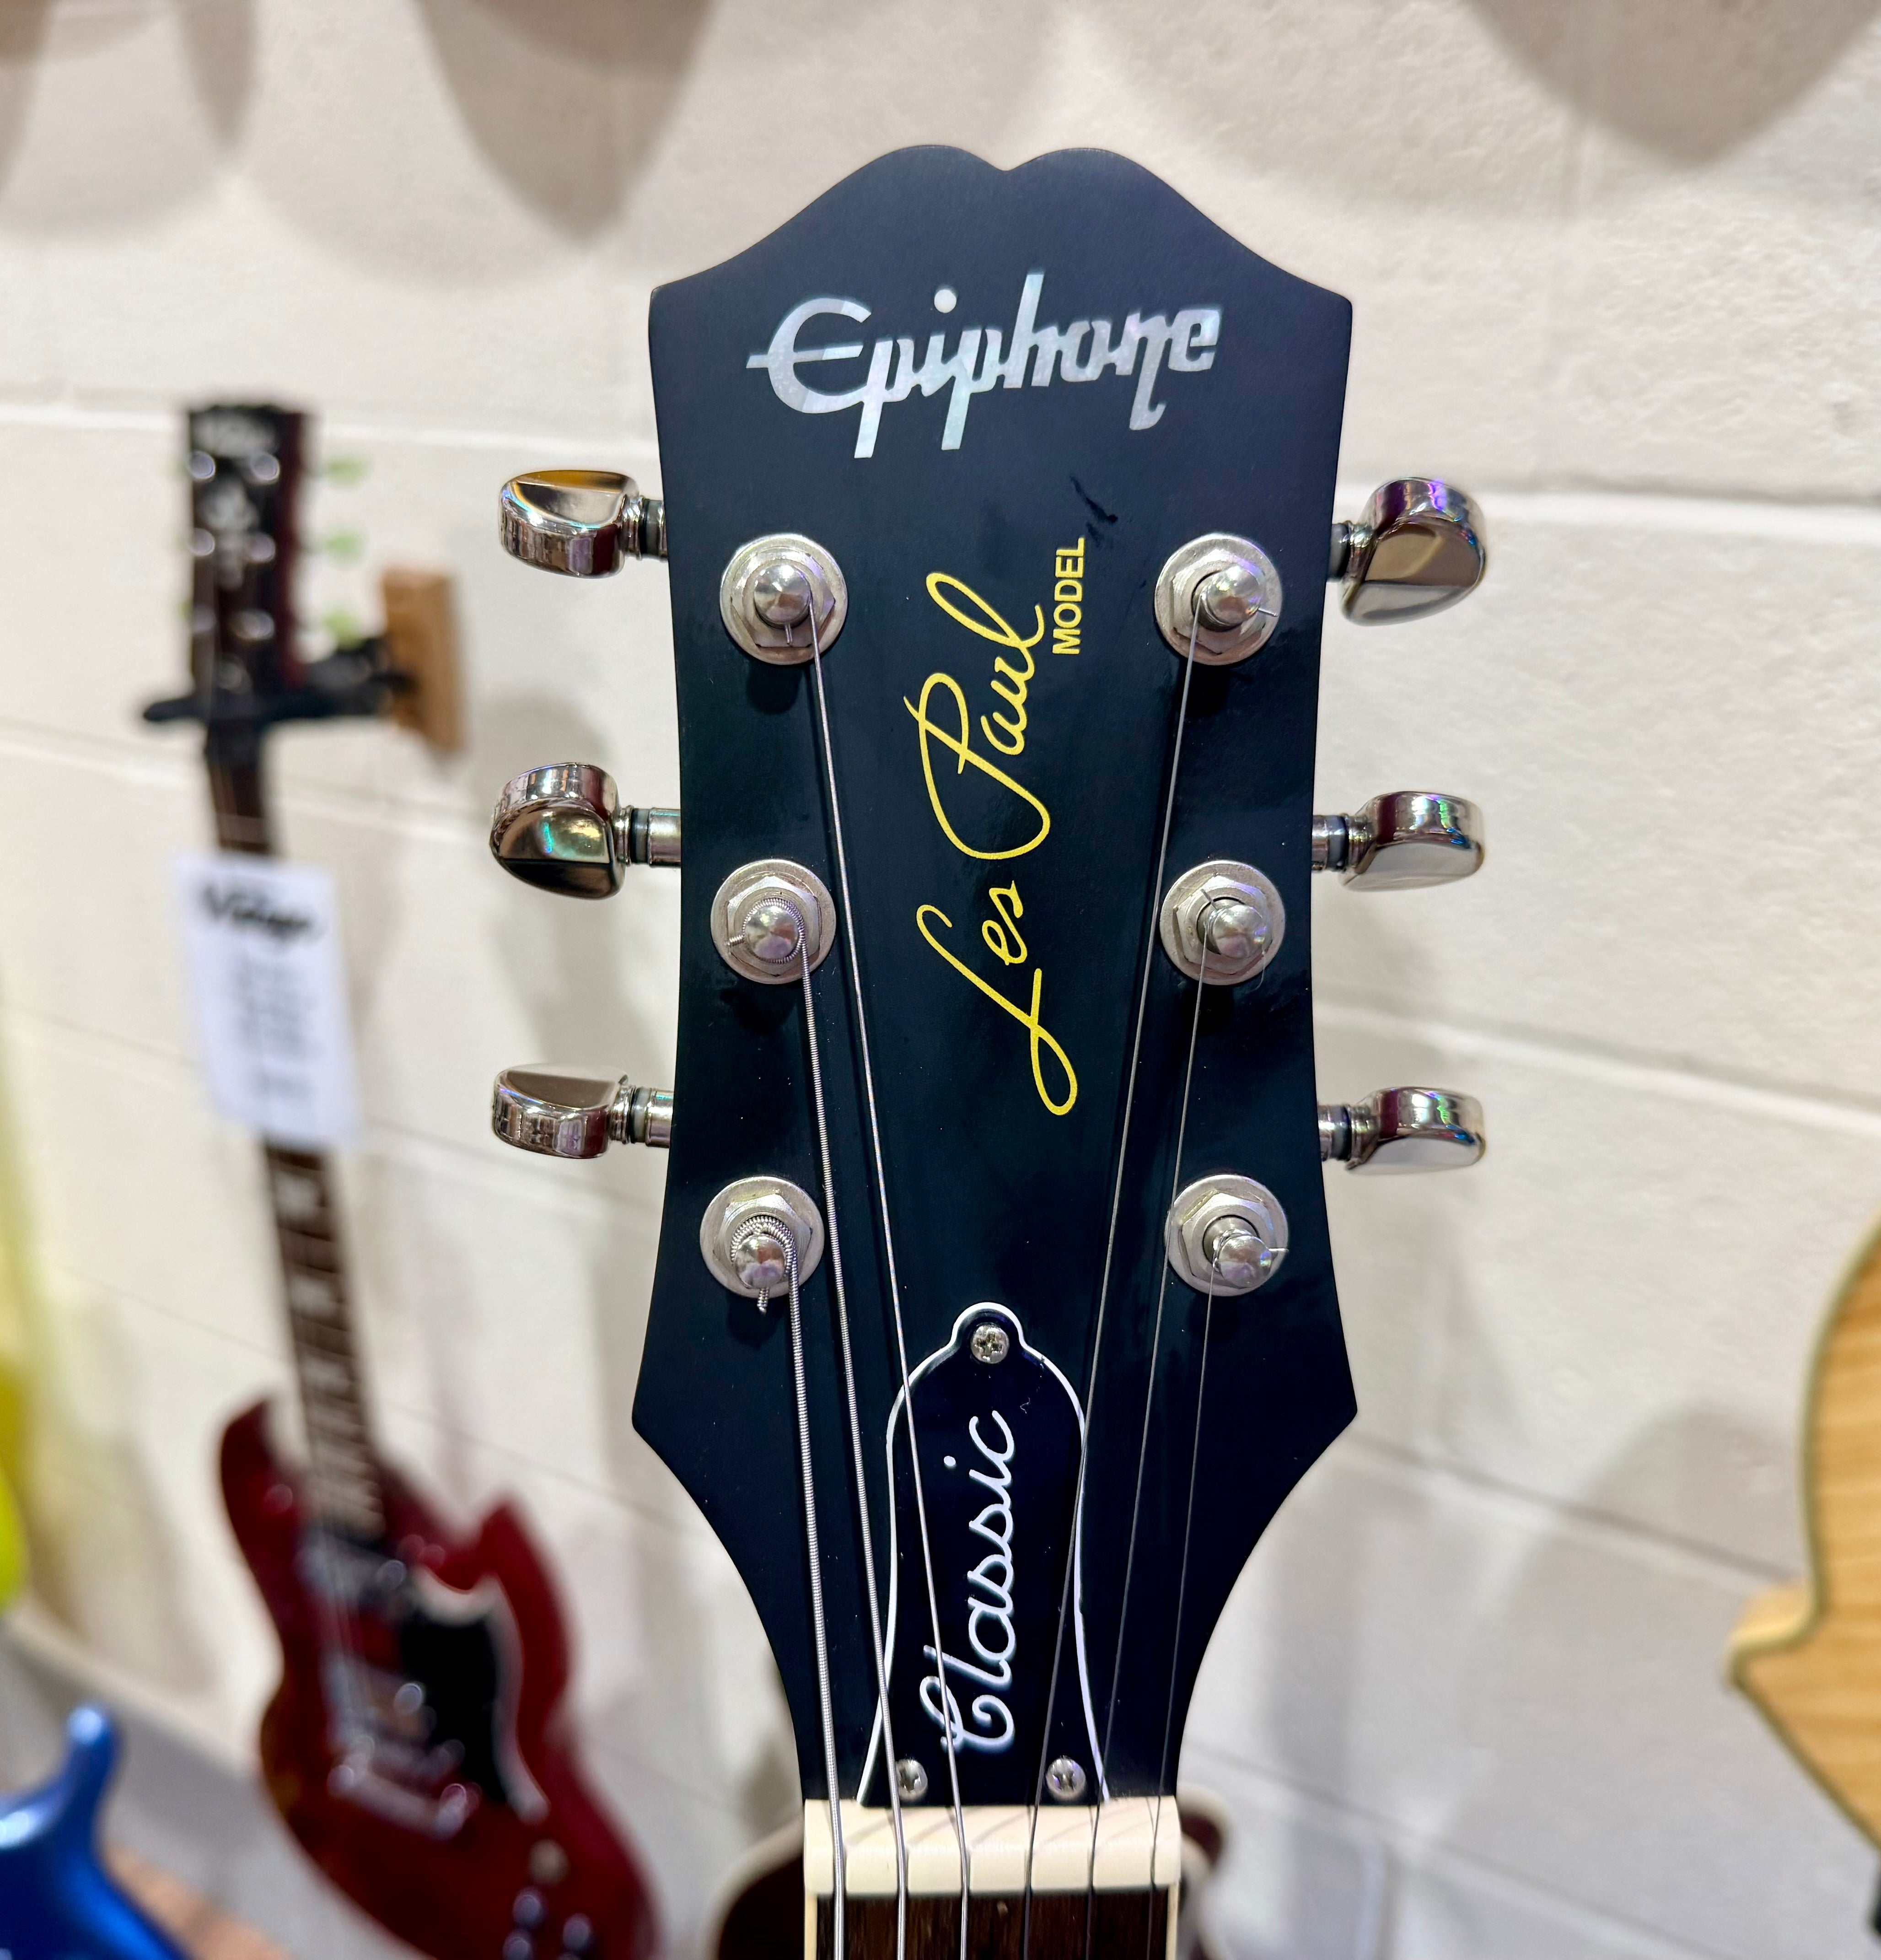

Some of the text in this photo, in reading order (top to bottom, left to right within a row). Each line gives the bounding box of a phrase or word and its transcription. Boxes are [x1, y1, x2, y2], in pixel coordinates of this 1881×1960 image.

[746, 270, 1222, 458] Epiphone
[1053, 537, 1086, 655] MODEL
[904, 572, 1078, 1116] Les Paul
[920, 1410, 1015, 1754] Classic
